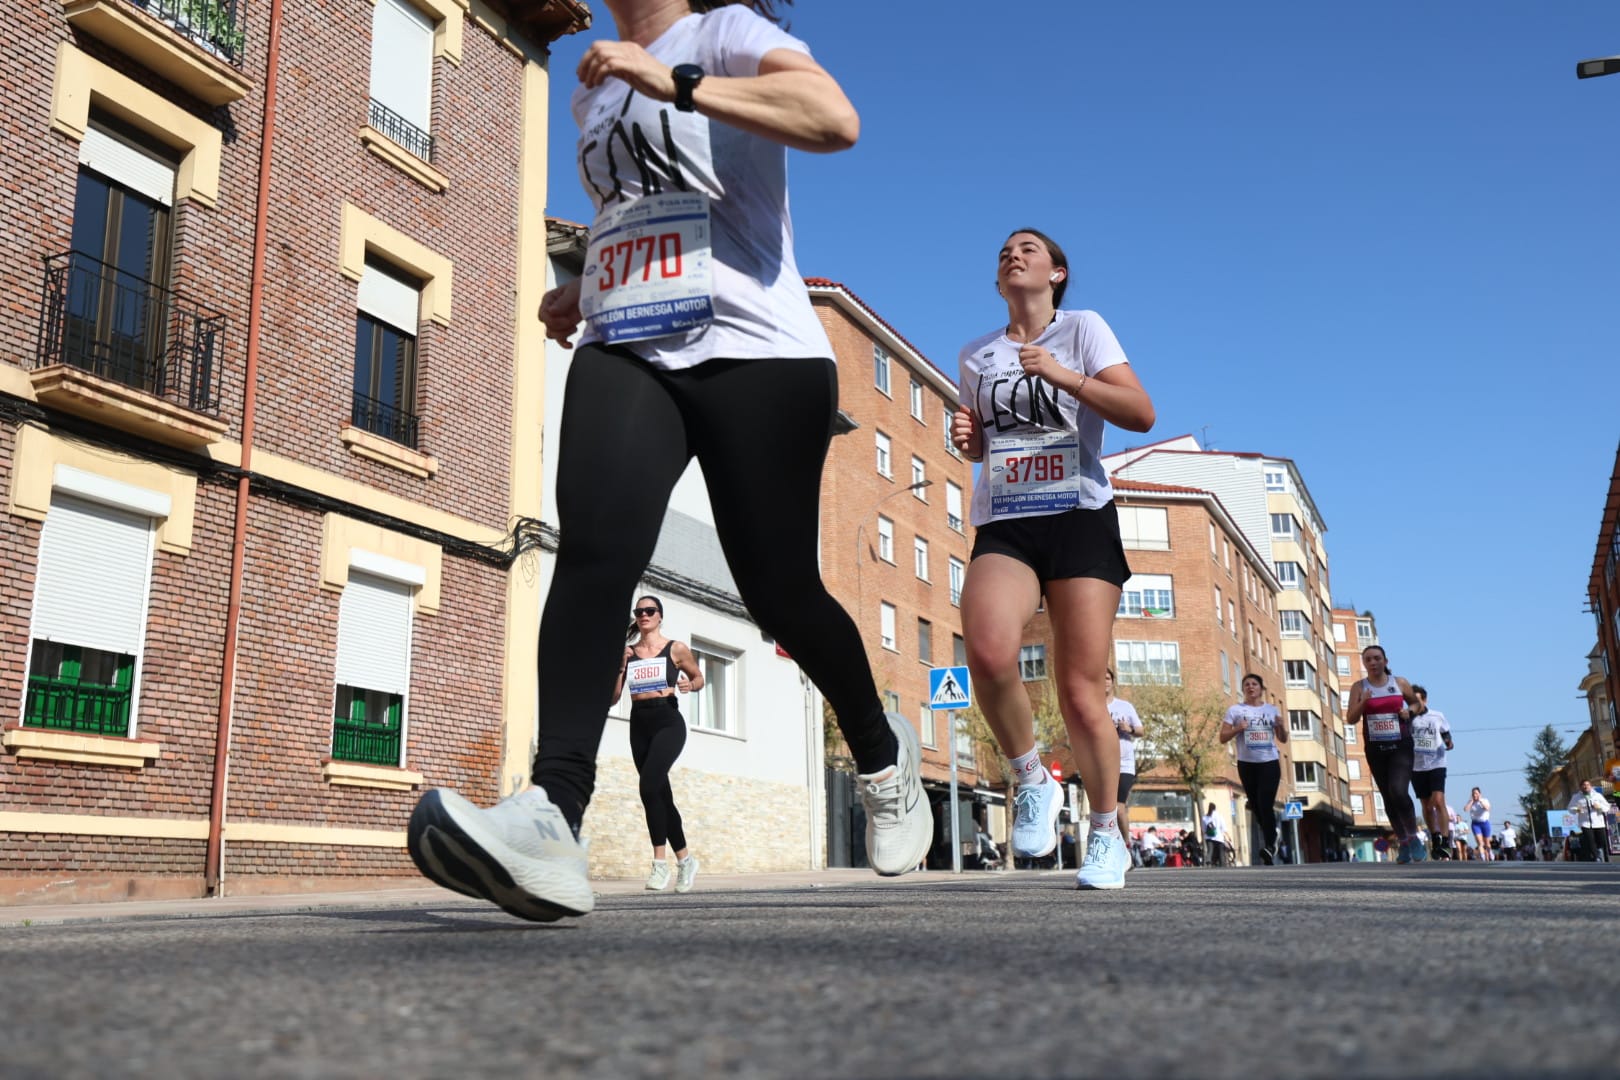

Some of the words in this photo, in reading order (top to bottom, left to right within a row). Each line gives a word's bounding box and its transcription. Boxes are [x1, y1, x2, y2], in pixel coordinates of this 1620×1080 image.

[598, 232, 682, 291] 3770
[626, 302, 673, 320] BERNESGA
[674, 298, 708, 314] MOTOR
[1006, 454, 1064, 484] 3796
[1028, 493, 1056, 502] BERNESGA
[1057, 492, 1078, 500] MOTOR
